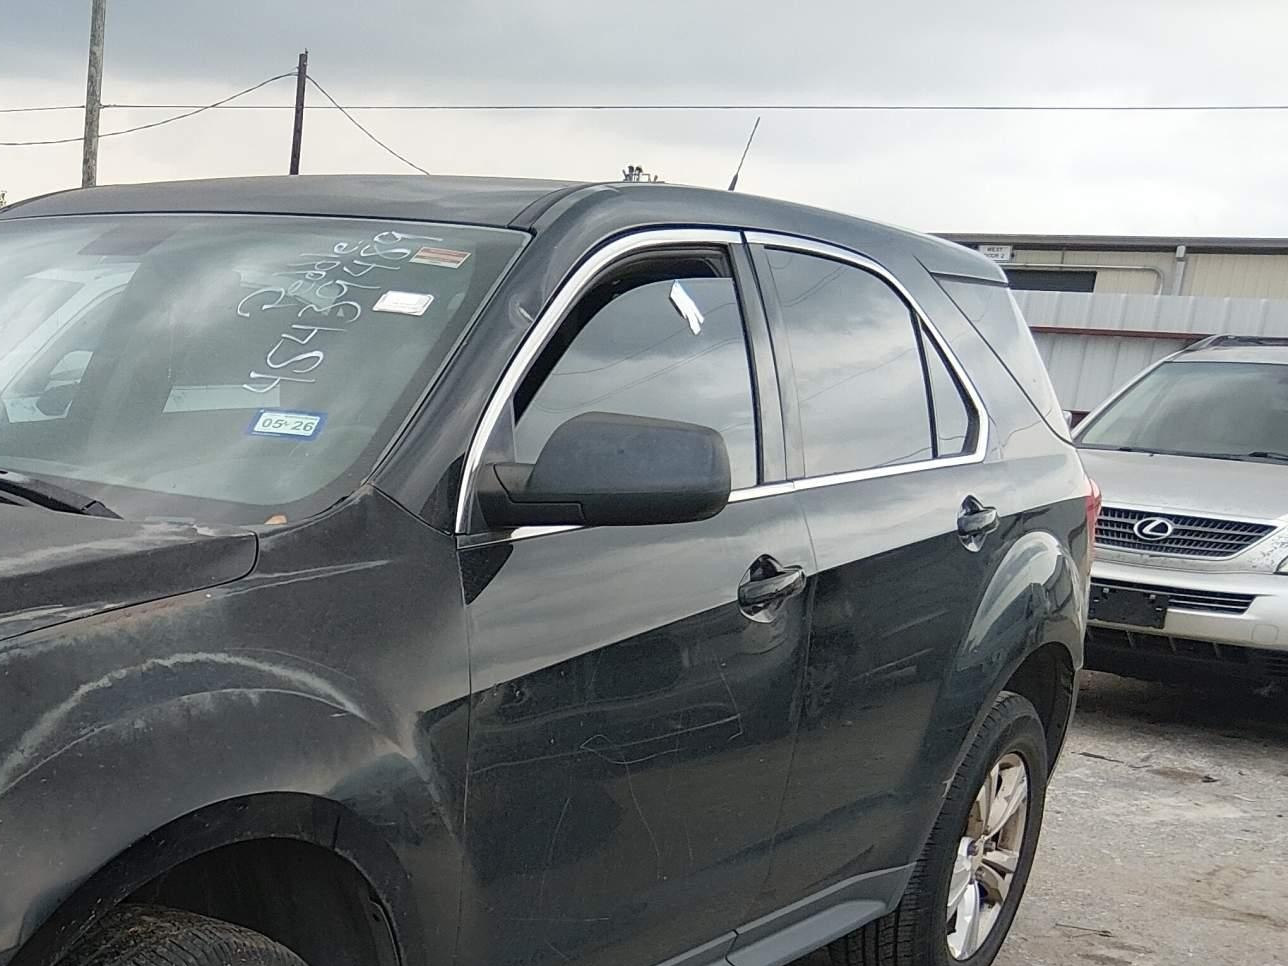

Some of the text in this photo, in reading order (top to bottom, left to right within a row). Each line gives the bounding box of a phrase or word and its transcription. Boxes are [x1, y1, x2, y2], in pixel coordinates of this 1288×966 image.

[242, 231, 443, 392] 45439489
[262, 418, 315, 432] 05 26
